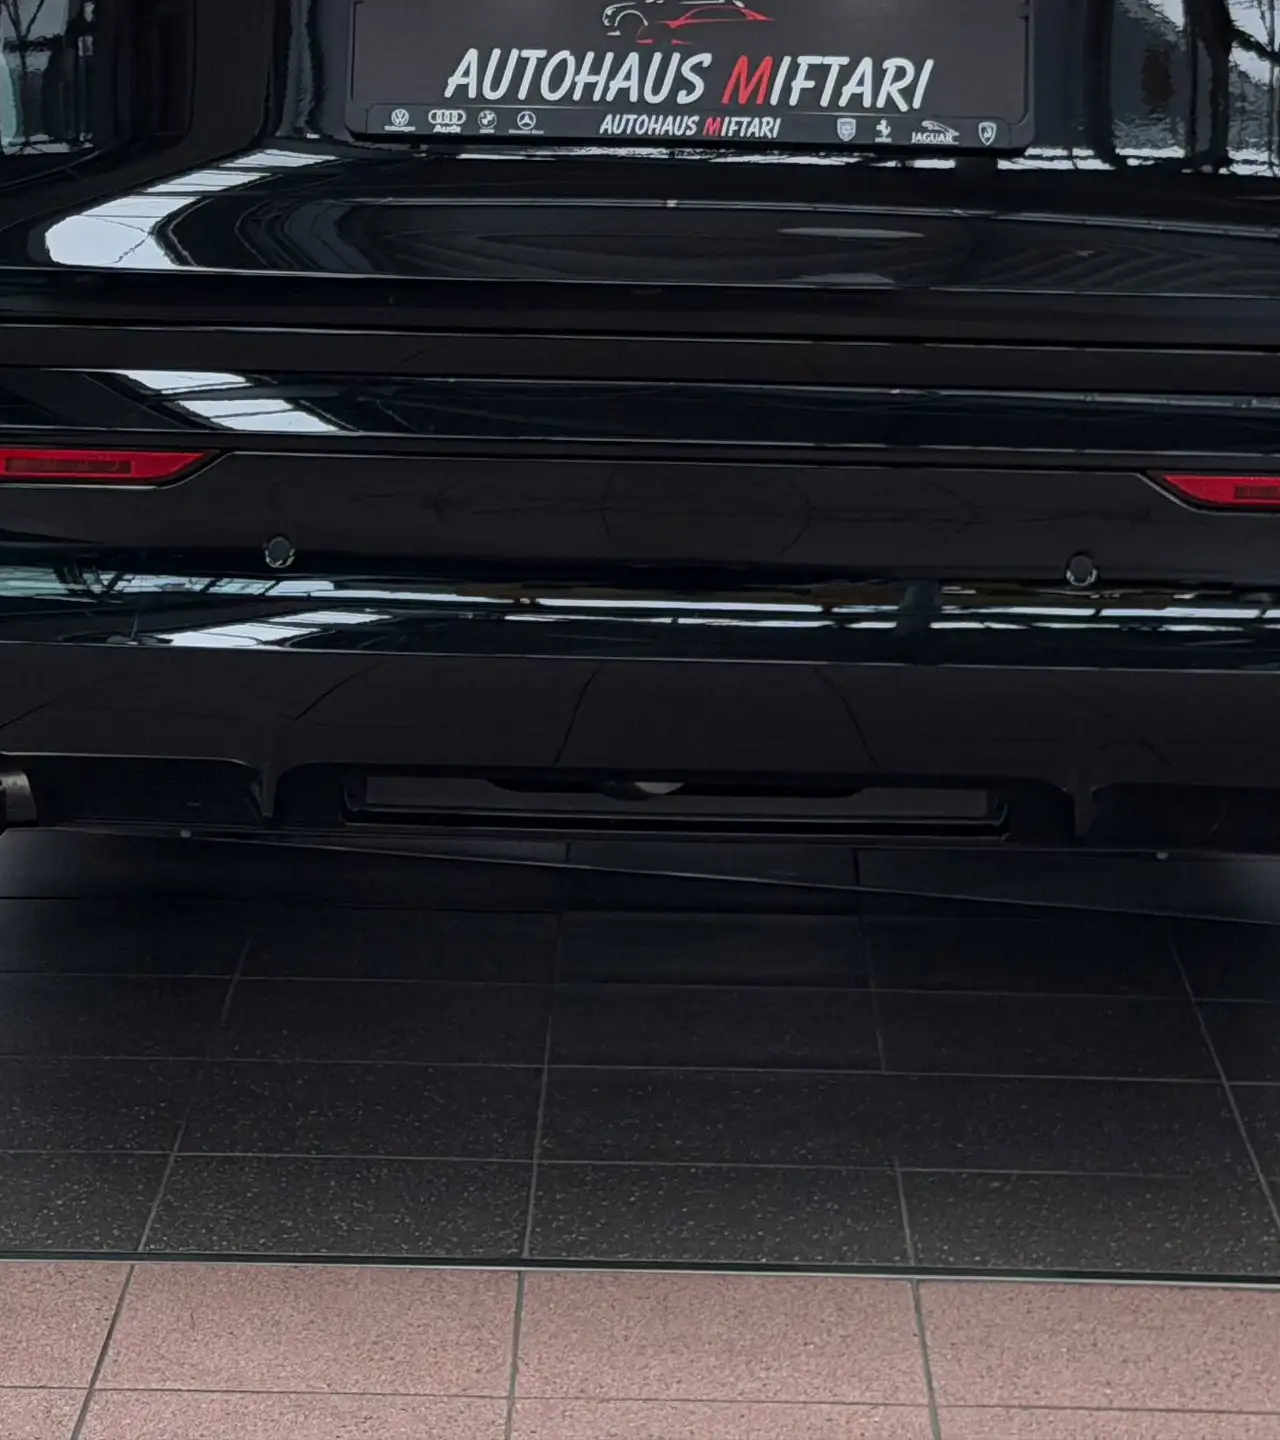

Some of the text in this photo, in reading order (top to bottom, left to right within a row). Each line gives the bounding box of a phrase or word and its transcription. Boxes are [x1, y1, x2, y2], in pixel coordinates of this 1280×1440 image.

[444, 47, 933, 112] AUTOHAUS MIFTARI
[433, 125, 462, 133] Audi
[599, 114, 781, 138] AUTOHAUS MIFTARI
[911, 131, 953, 144] JAGUAR
